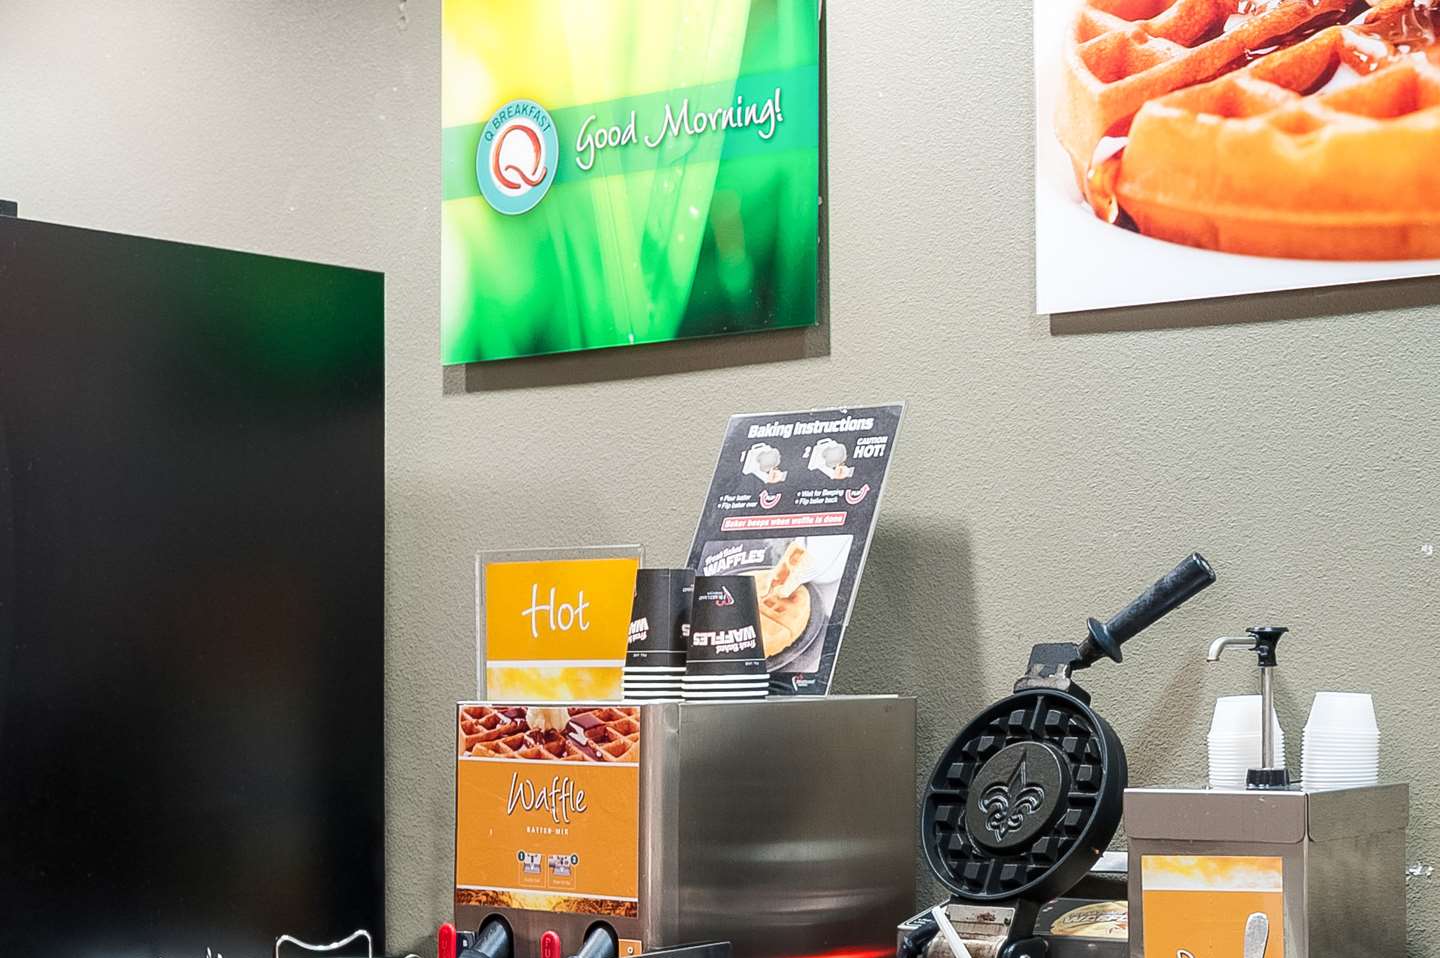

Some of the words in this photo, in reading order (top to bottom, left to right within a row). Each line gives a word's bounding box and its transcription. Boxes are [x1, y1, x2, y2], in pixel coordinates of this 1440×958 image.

[484, 131, 494, 142] Q
[492, 103, 552, 133] BREAKFAST
[576, 110, 638, 171] Good
[644, 87, 784, 148] Morning!
[492, 125, 548, 190] Q
[748, 421, 794, 439] Baking
[793, 416, 875, 436] Instructions
[803, 446, 812, 459] 2
[853, 444, 886, 459] HOT!
[703, 549, 766, 577] WAFFLES
[520, 583, 591, 638] Hot
[692, 625, 757, 647] WAFFLES
[507, 771, 588, 824] Waffle
